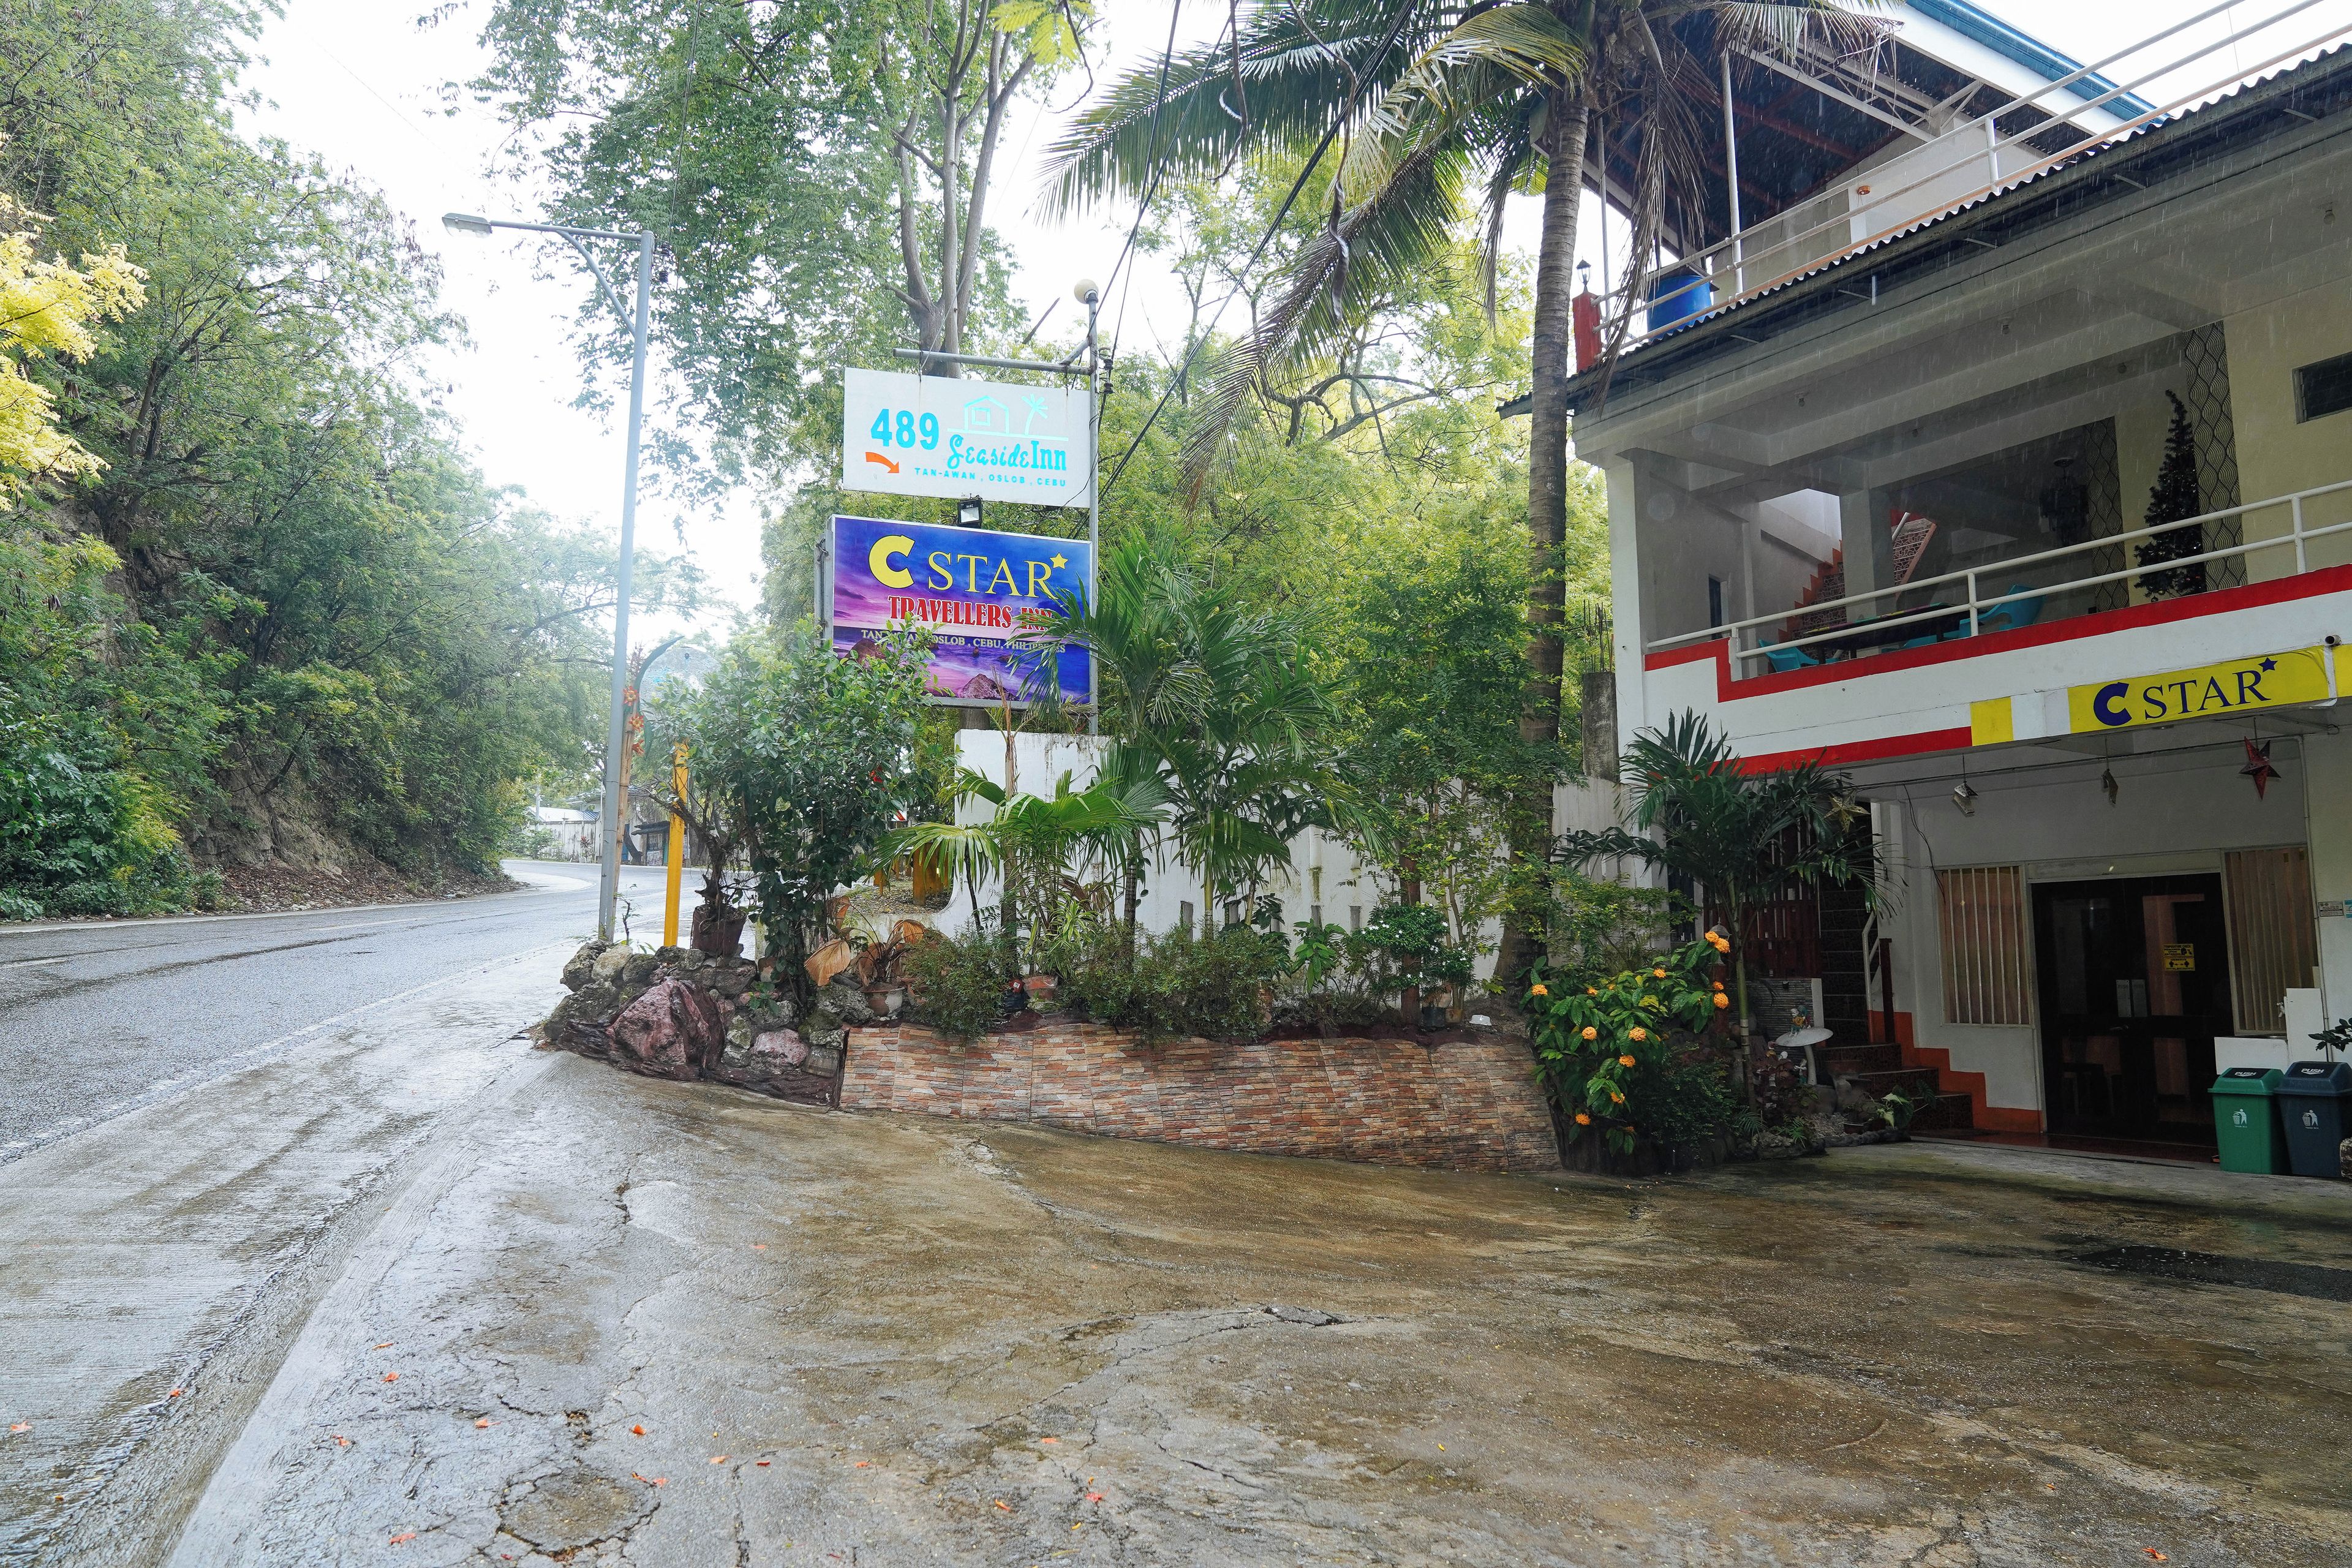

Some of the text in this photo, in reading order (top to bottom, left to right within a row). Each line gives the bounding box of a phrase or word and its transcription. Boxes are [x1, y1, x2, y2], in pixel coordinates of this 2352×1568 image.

[870, 409, 940, 451] 489
[948, 434, 1030, 470] Seaside
[914, 467, 976, 480] TAN-AWAN
[989, 473, 1025, 484] OSLOB
[1037, 477, 1066, 487] CEBU
[869, 535, 1059, 600] C STAR
[888, 595, 1012, 629] TRAVELLERS
[973, 638, 1003, 650] CEBU,
[2093, 670, 2271, 726] C STAR
